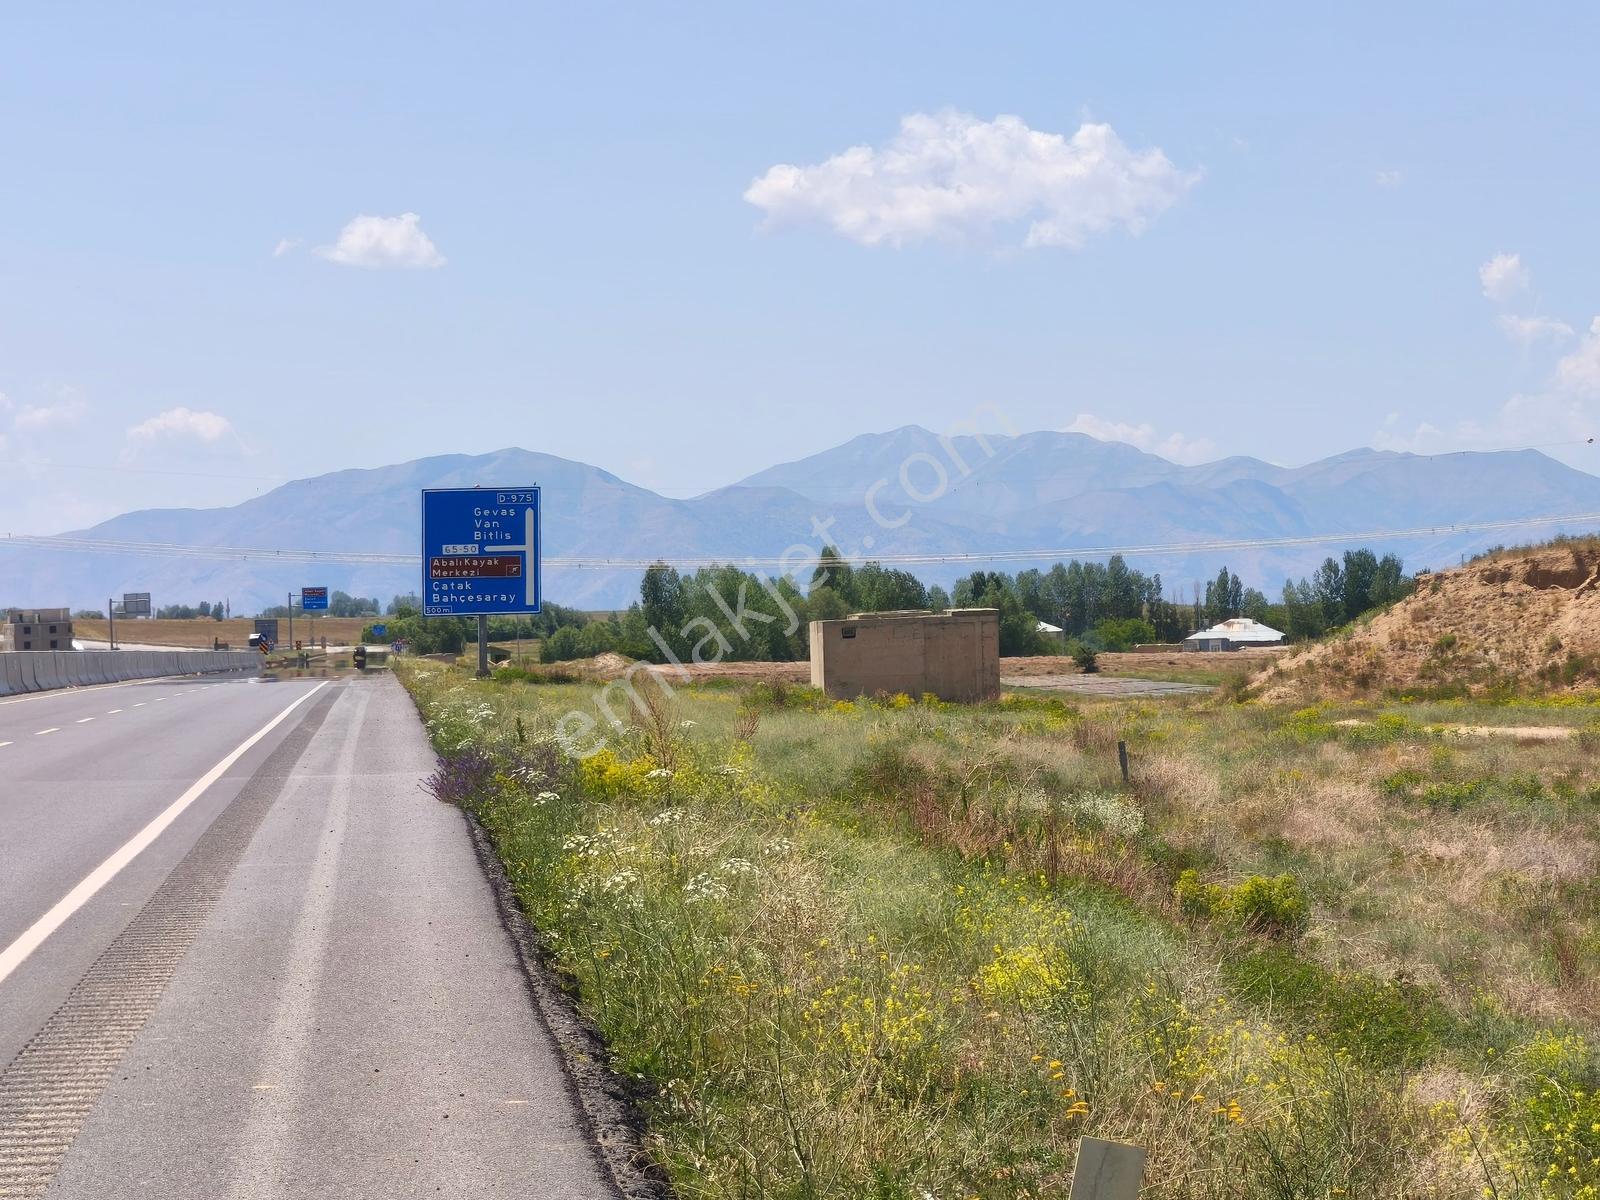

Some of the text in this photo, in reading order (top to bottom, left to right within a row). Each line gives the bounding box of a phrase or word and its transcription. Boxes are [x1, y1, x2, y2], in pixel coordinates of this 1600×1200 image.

[499, 494, 532, 503] D-975
[474, 519, 500, 528] Van
[474, 531, 512, 540] Bitlis
[444, 545, 477, 554] 65-50
[464, 557, 500, 568] Kayak
[432, 568, 480, 577] Merkezi
[432, 581, 472, 592] Çatak
[432, 593, 516, 604] Bahçesaray
